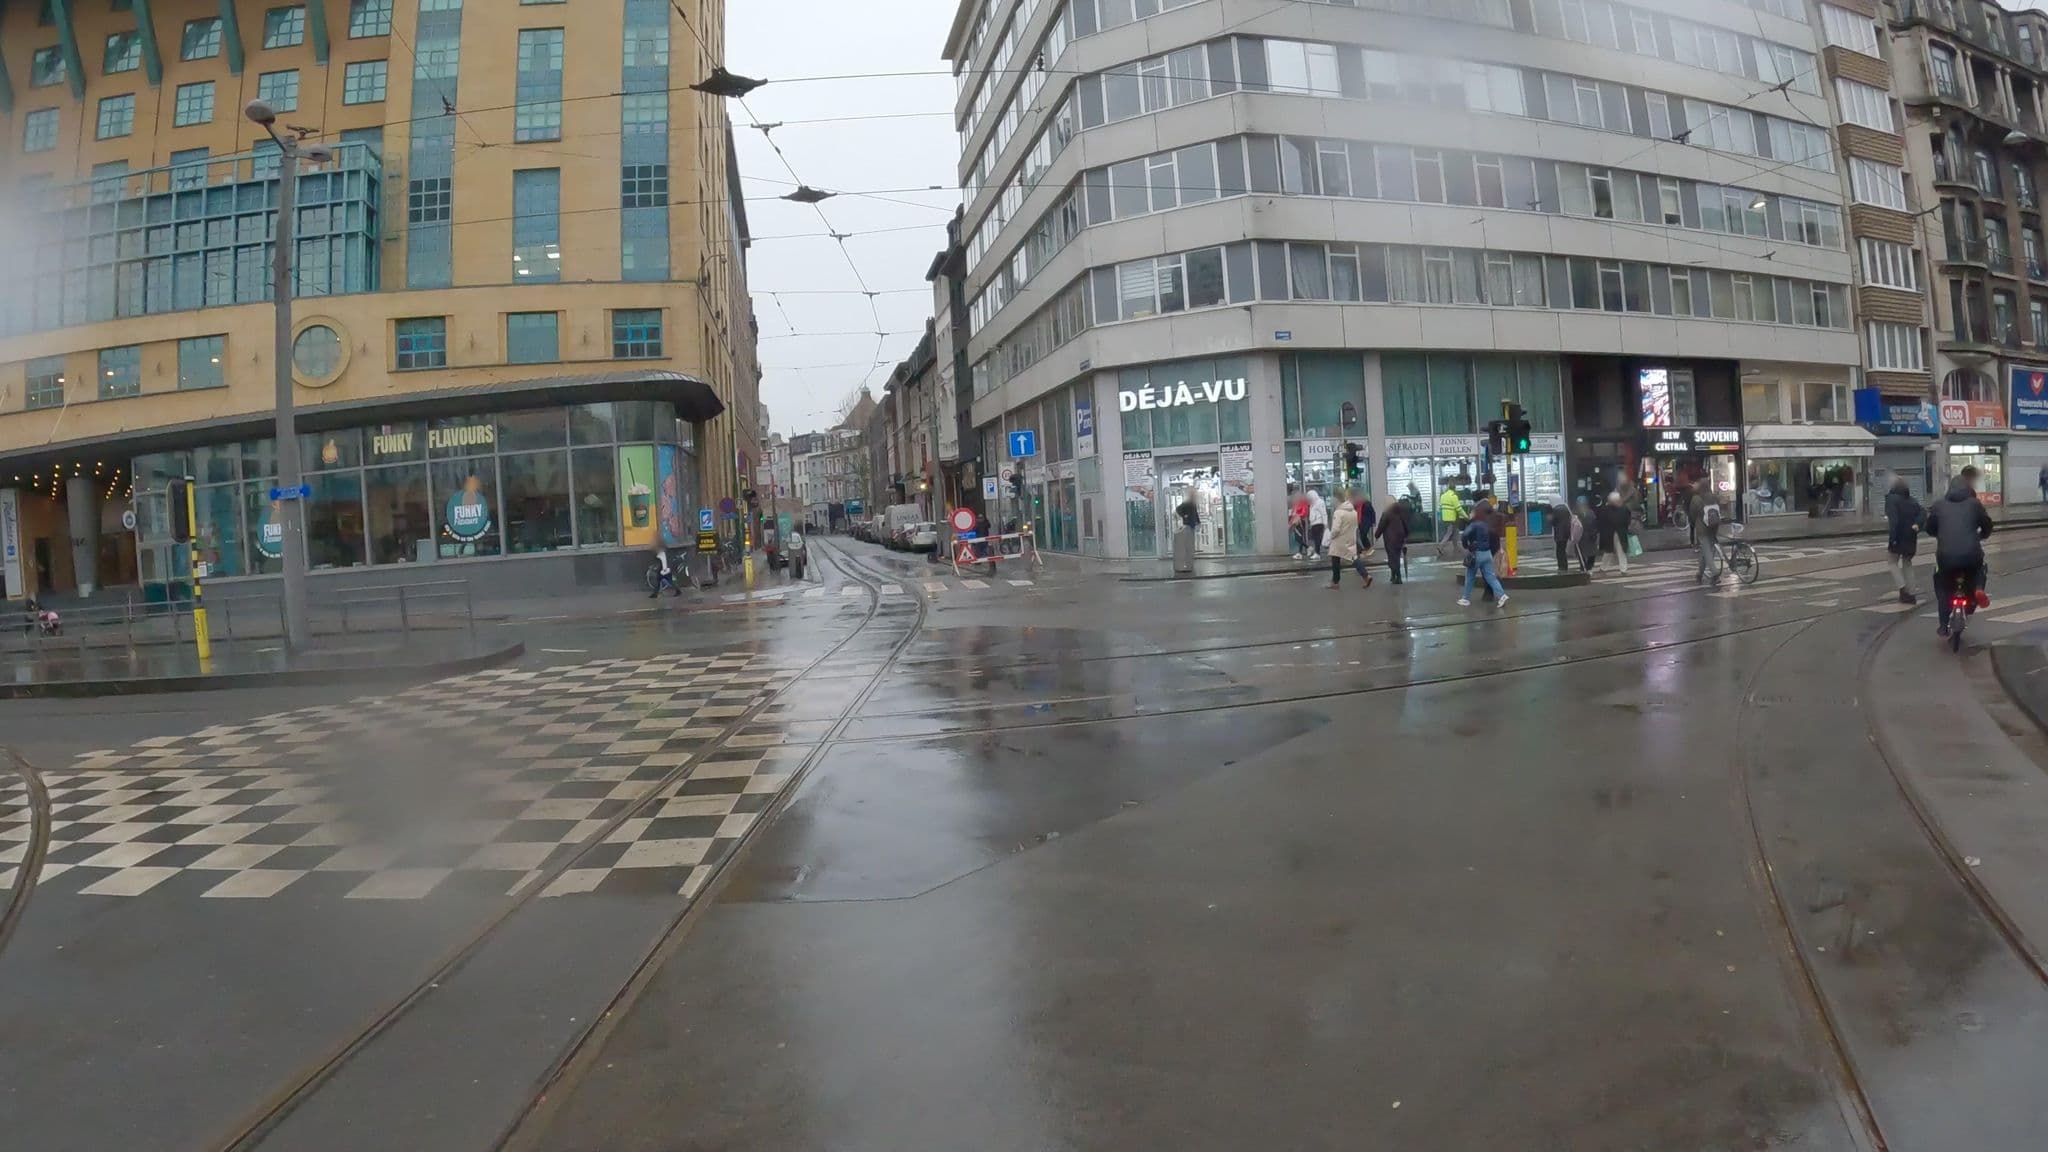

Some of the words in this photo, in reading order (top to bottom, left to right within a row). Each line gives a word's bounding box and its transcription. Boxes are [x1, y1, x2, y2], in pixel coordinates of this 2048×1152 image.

[373, 432, 413, 455] FUNKY
[429, 424, 493, 448] FLAVOURS
[1662, 431, 1680, 440] NEW
[1694, 431, 1739, 442] SOUVENIR
[1388, 442, 1430, 451] SIERADEN
[1439, 446, 1472, 454] BRILLEN
[1655, 442, 1688, 451] CENTRAL
[454, 504, 482, 518] FUNKY
